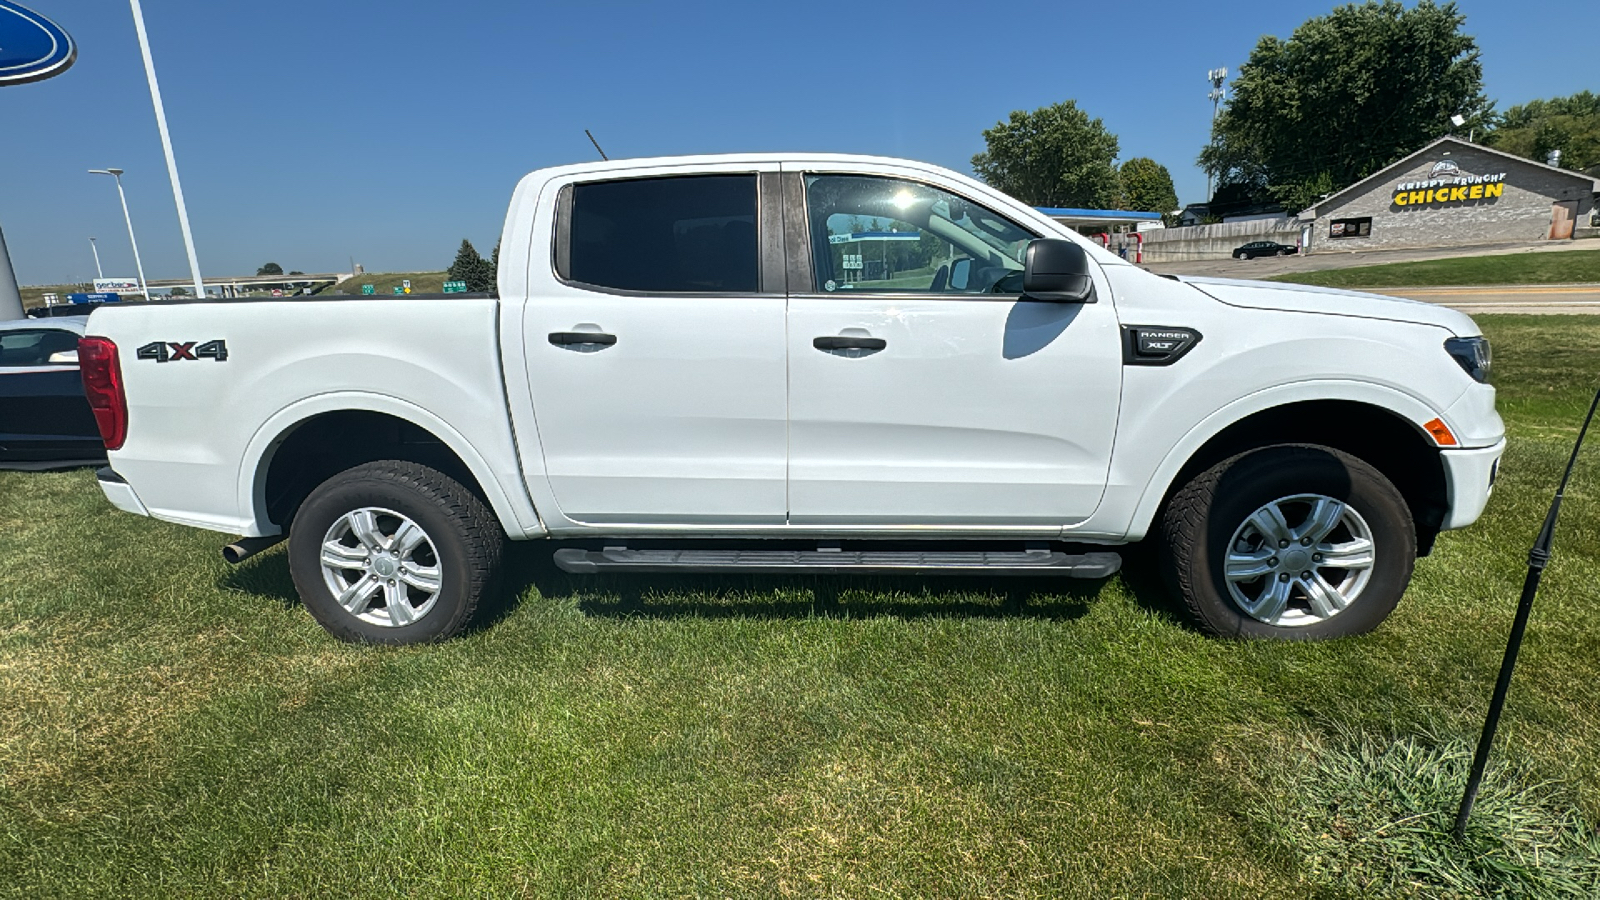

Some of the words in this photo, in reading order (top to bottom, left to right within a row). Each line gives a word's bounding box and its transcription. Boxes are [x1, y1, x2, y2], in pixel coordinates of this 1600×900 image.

[1397, 179, 1446, 191] KRISPY
[1453, 172, 1507, 186] KRUNCHY
[1394, 182, 1504, 206] CHICKEN
